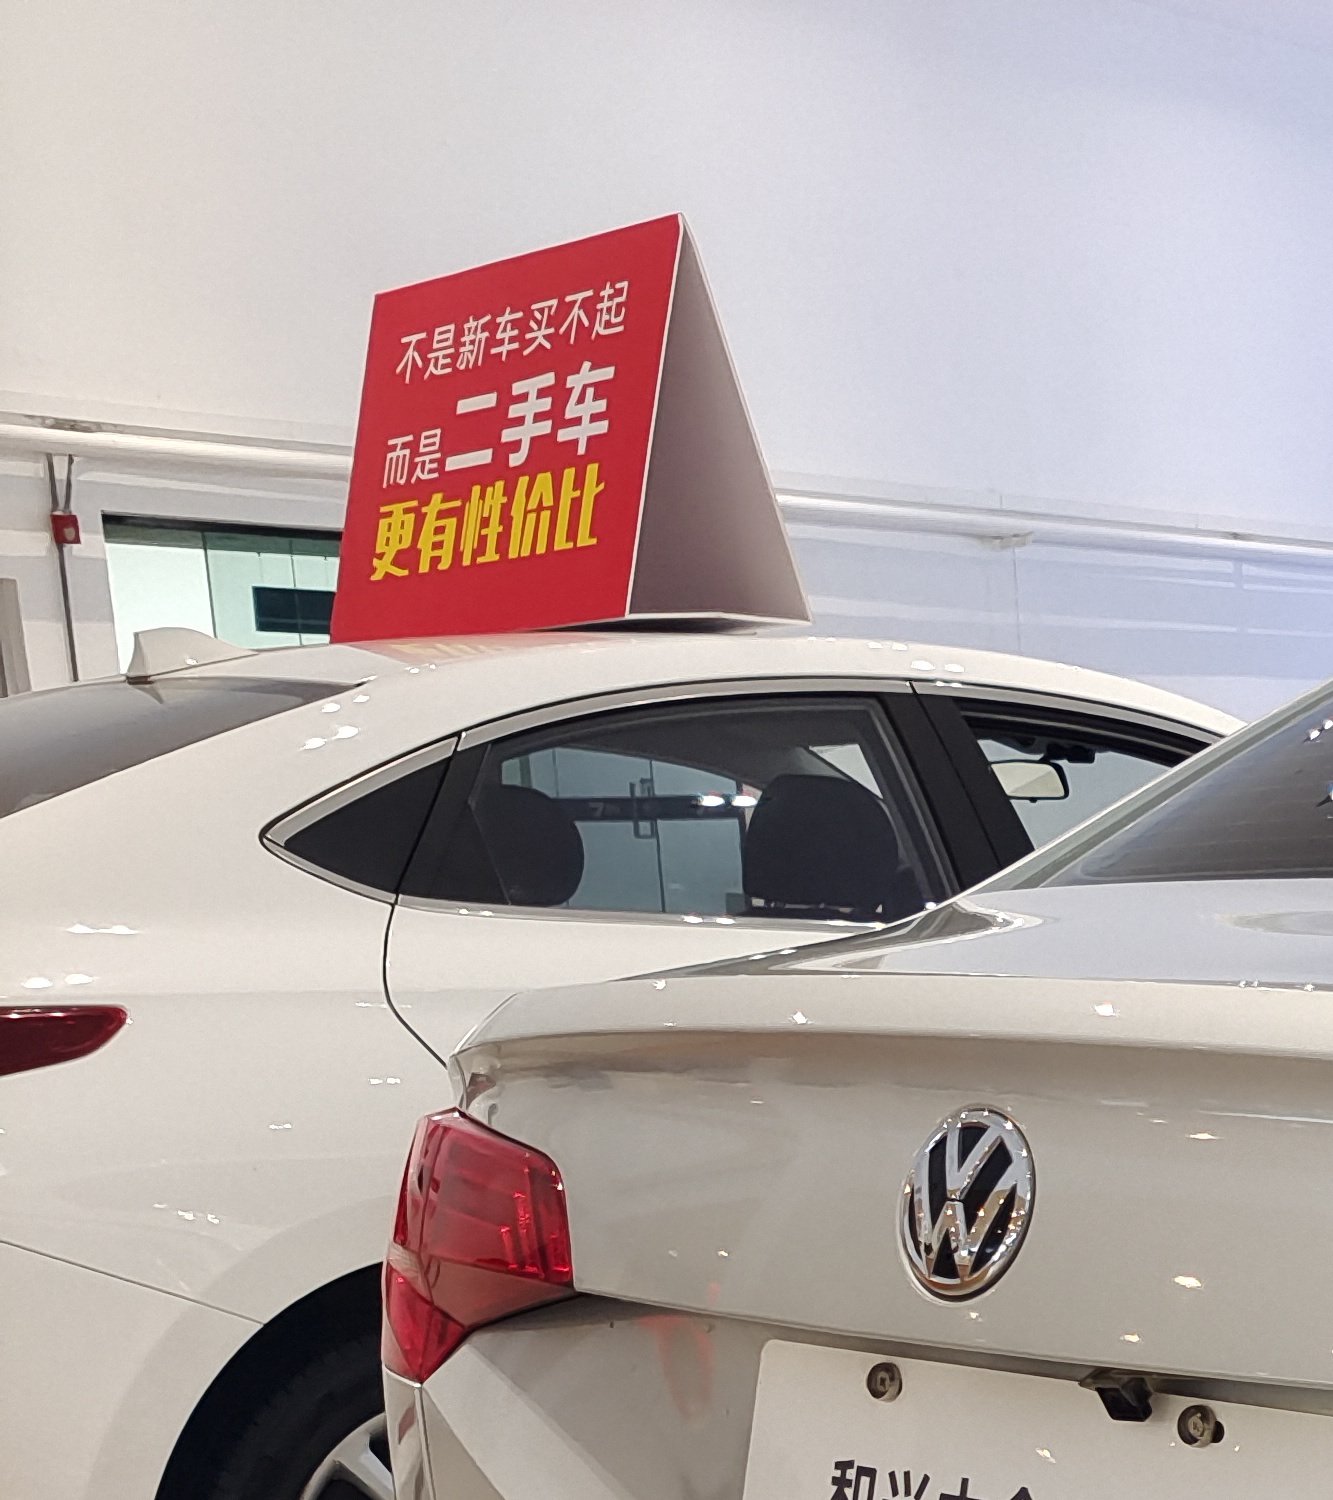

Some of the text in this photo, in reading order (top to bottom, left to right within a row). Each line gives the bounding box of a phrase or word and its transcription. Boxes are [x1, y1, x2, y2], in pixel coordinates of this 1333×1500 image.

[395, 280, 629, 384] 不是新车买不起
[382, 361, 615, 489] 而是二手车
[369, 462, 605, 581] 更有性价比
